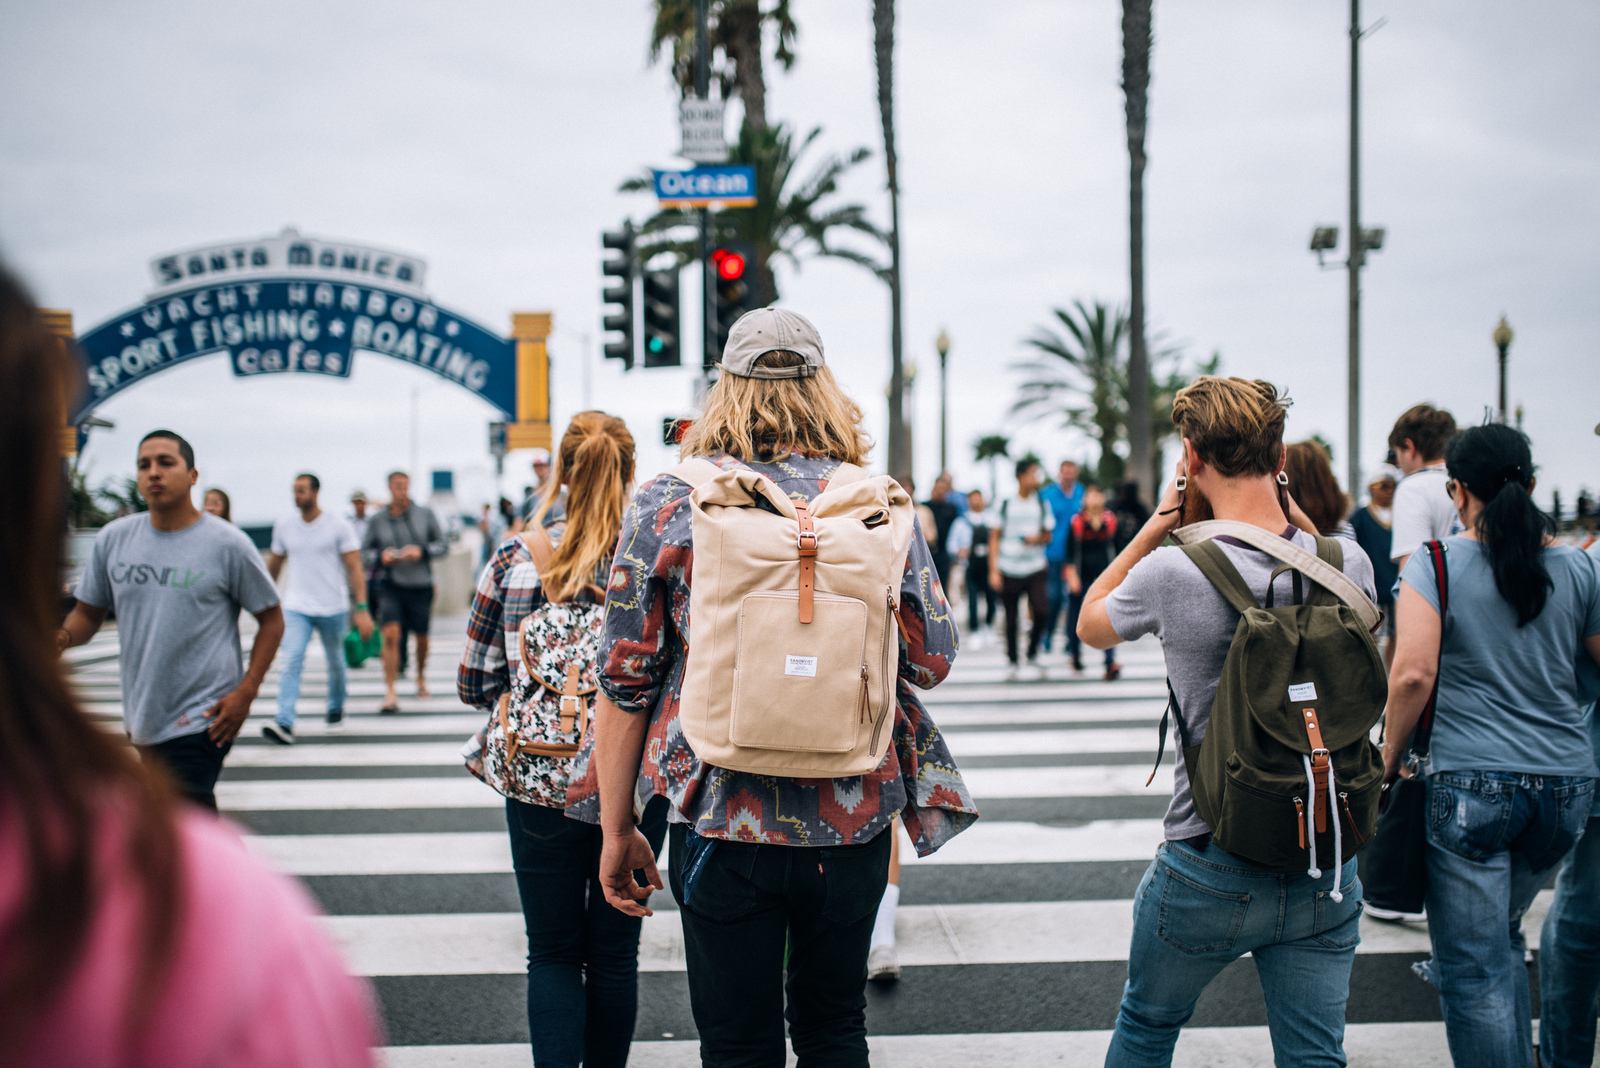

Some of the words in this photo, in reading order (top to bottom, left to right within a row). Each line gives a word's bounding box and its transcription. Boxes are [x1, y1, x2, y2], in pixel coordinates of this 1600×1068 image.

[660, 172, 748, 195] Ocean
[142, 284, 262, 331] YACHT
[288, 282, 438, 331] HARBOR
[88, 328, 179, 396] SPORT
[191, 308, 320, 351] FISHING
[352, 315, 490, 391] BOATING
